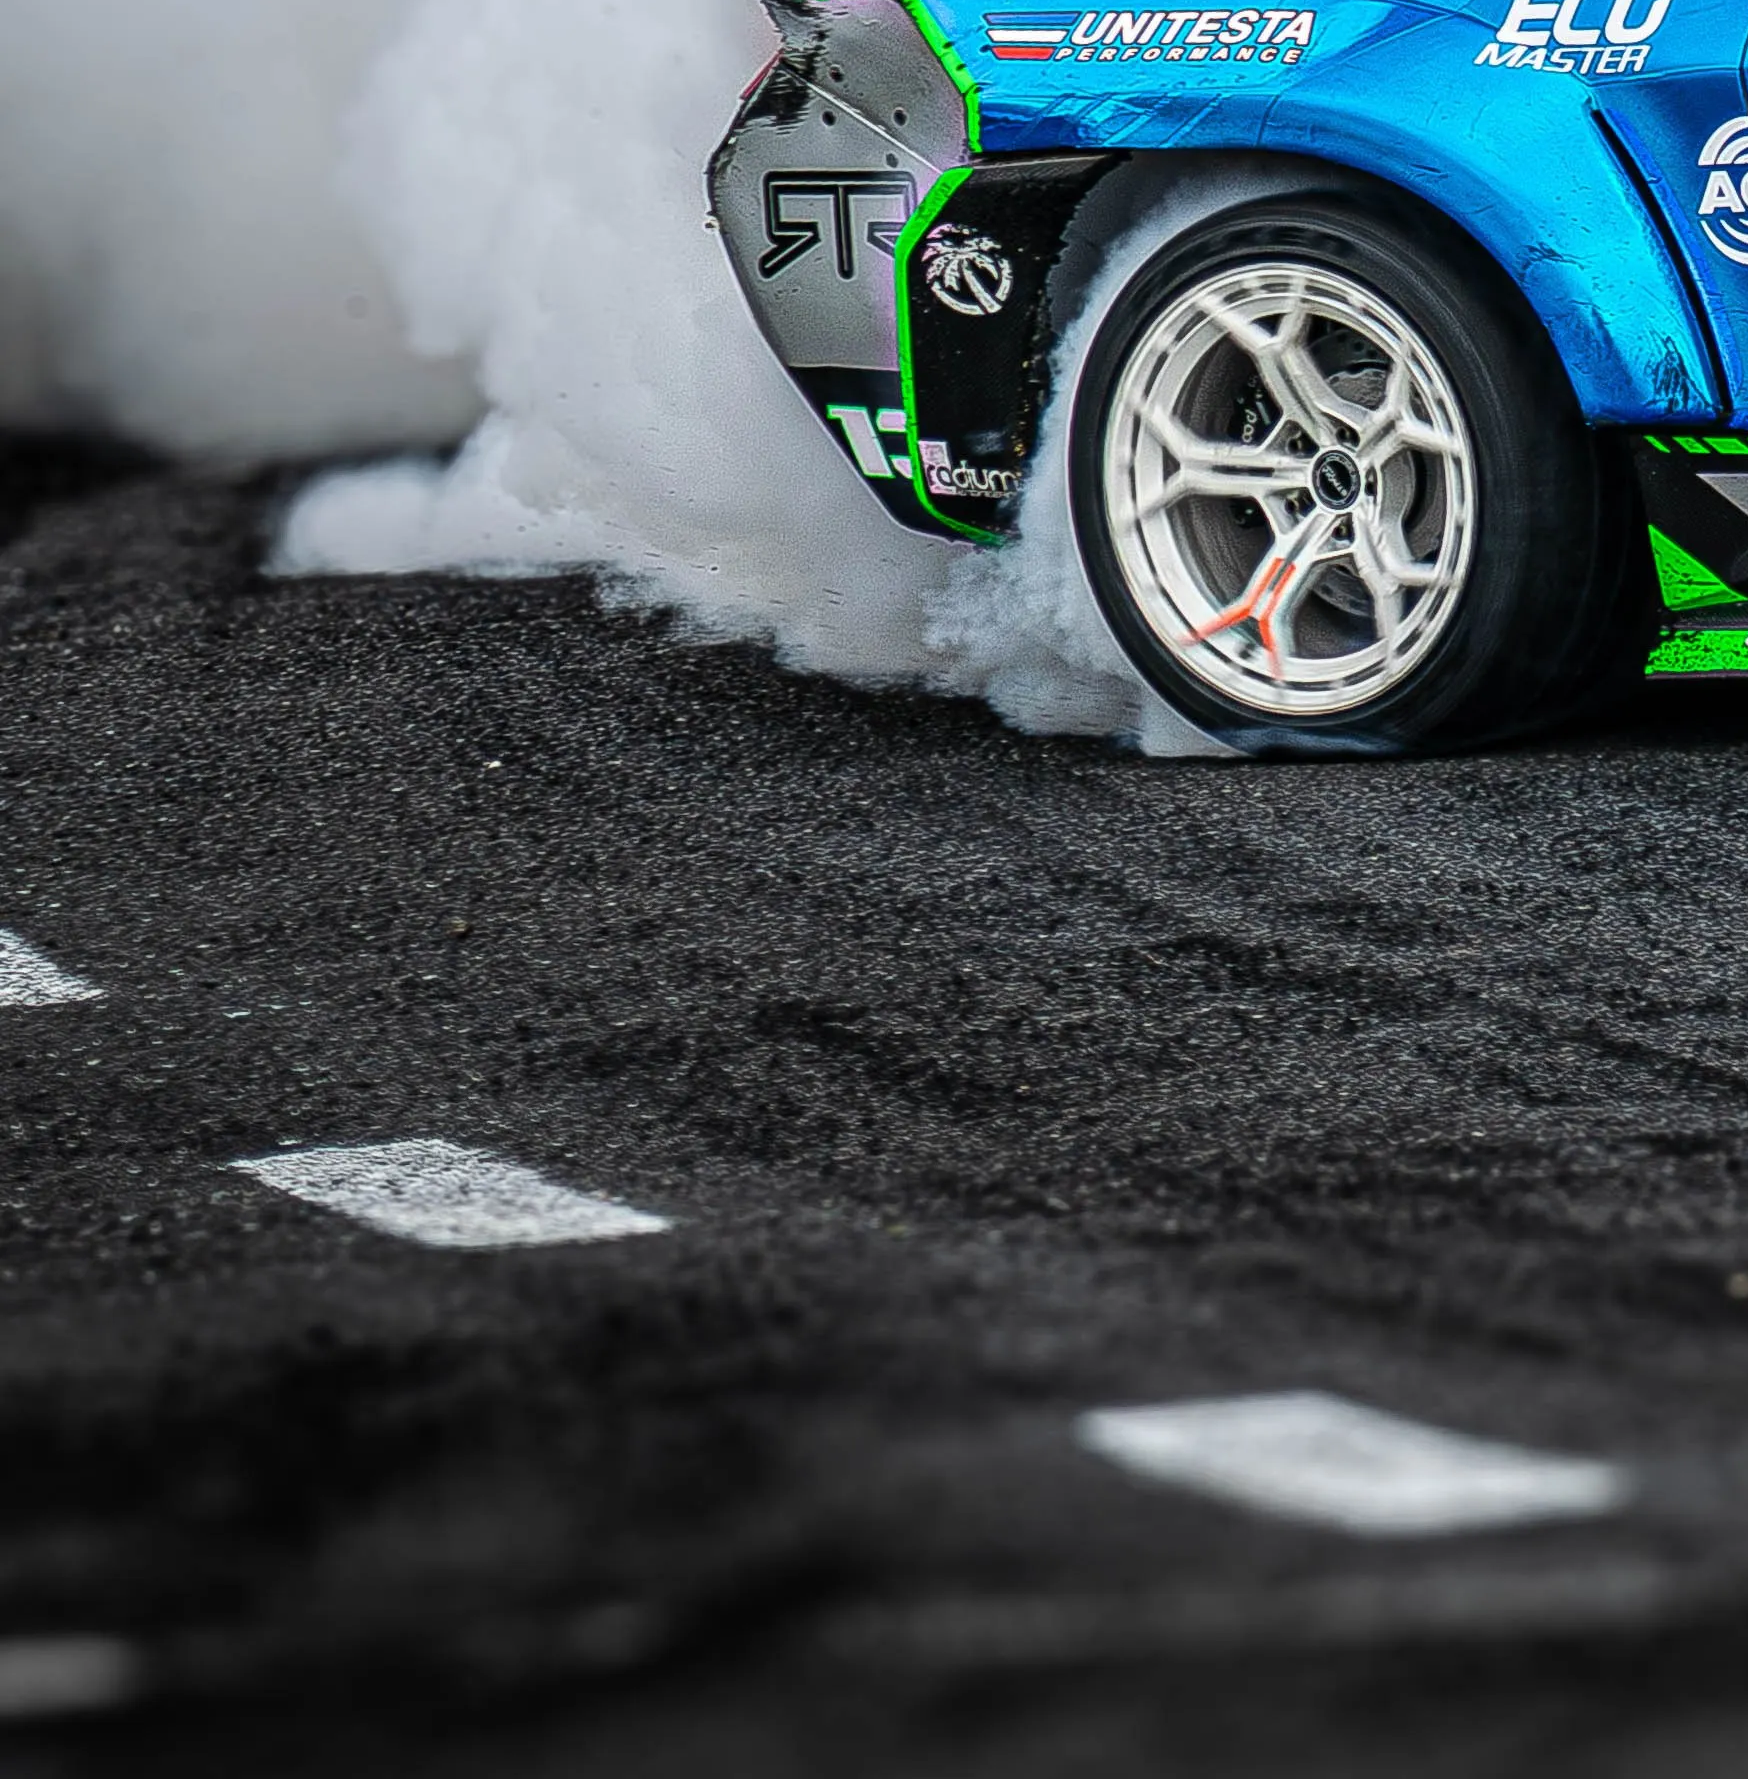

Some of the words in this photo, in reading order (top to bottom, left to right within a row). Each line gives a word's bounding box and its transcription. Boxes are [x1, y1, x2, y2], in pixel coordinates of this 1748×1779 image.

[1070, 8, 1316, 46] UNITESTA
[1053, 47, 1303, 65] PERFORMANCE
[1473, 42, 1651, 74] MASTER
